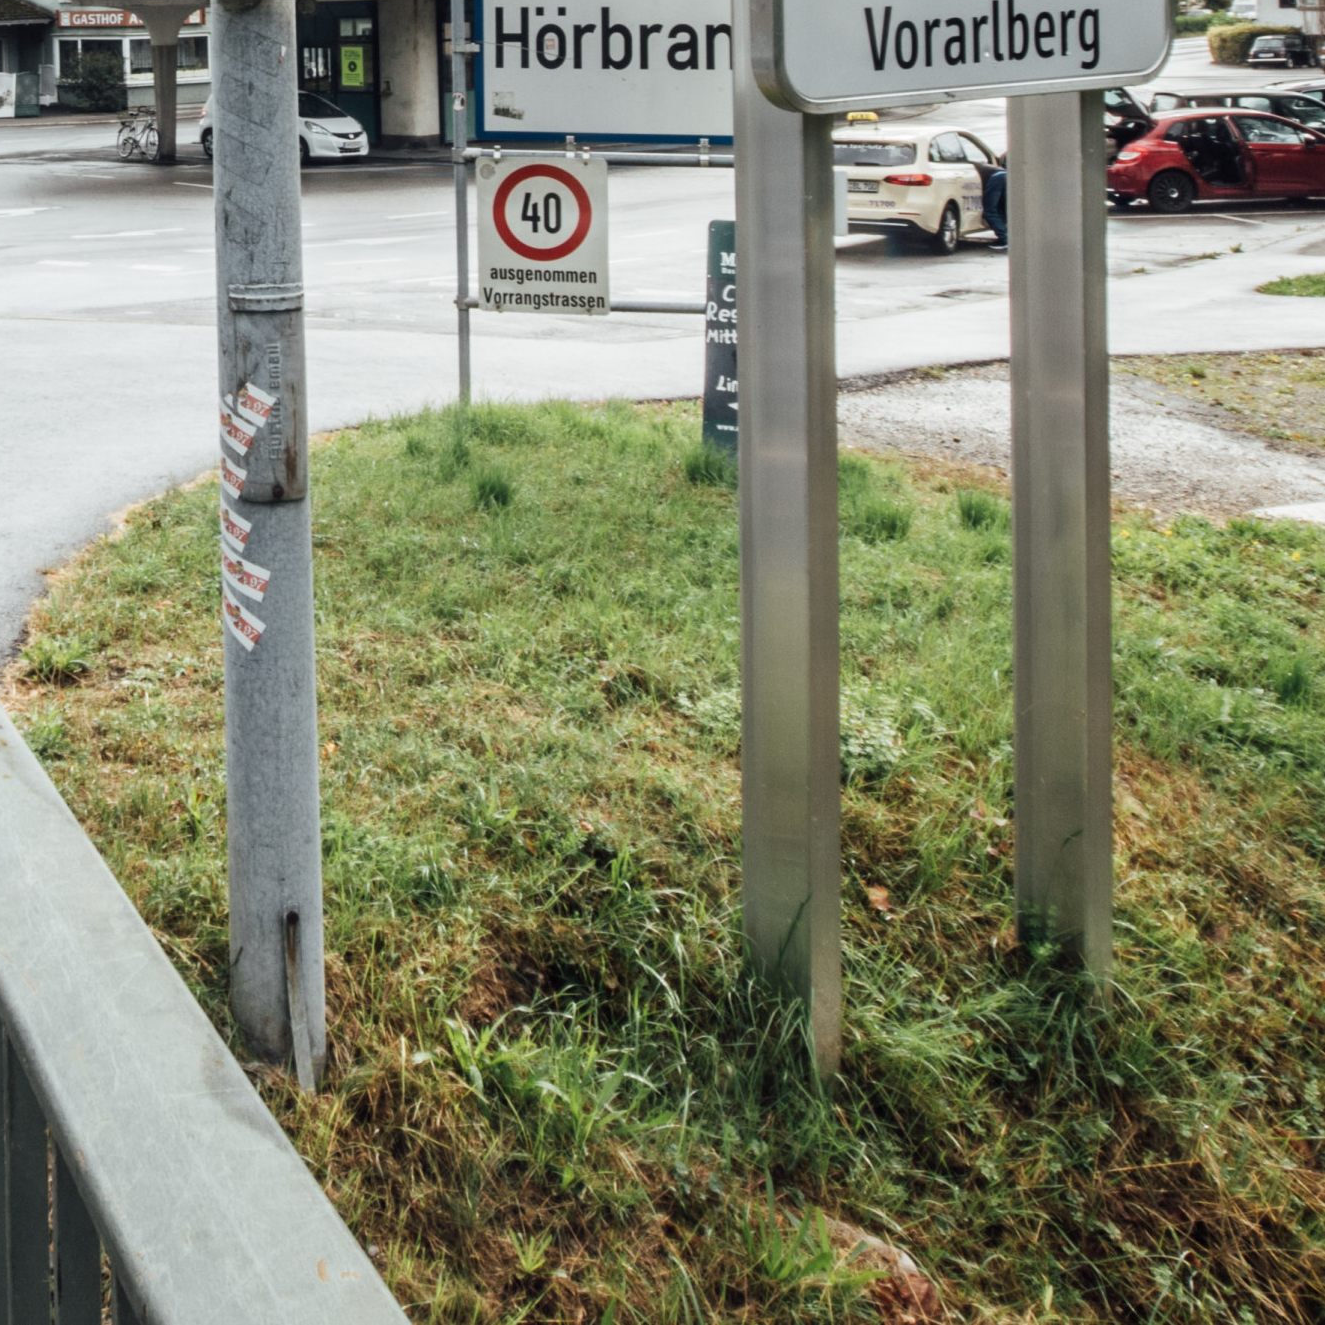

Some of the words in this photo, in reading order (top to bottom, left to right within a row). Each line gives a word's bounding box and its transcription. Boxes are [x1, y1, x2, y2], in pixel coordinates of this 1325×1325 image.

[72, 13, 124, 25] GASTHOF
[863, 0, 1100, 72] Vorarlberg
[521, 192, 562, 234] 40
[490, 267, 597, 284] ausgenommen
[483, 287, 606, 310] Vorrangstrassen
